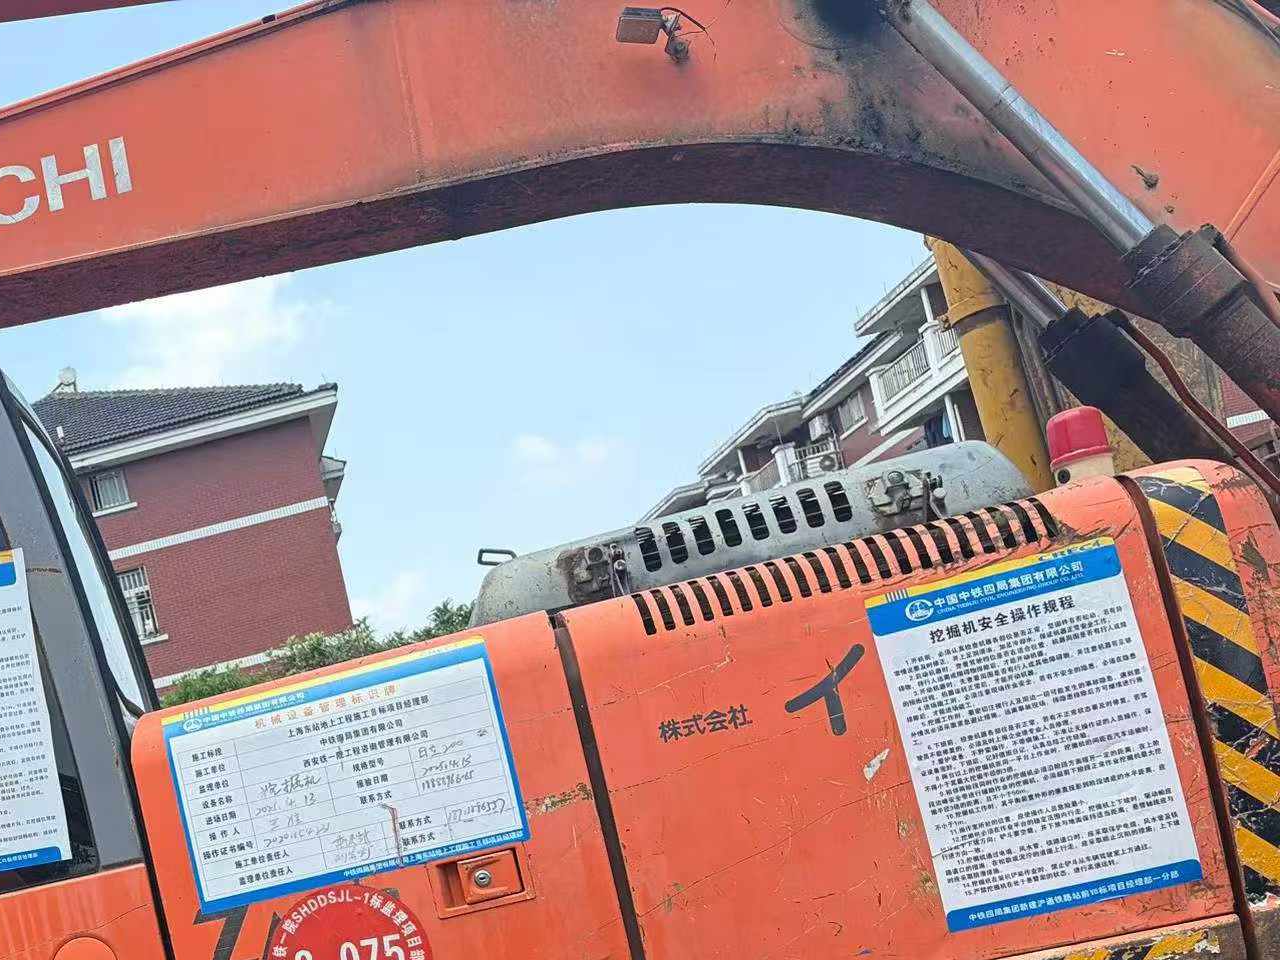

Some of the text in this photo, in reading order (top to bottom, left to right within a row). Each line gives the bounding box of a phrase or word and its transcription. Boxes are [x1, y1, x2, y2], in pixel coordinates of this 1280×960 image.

[932, 559, 1083, 608] 中国中铁四局集团有限公司
[928, 593, 1075, 644] 挖掘机安全操作规程
[658, 703, 754, 744] 株式会社
[191, 747, 222, 762] 施工标段
[194, 762, 226, 777] 施工单位
[351, 757, 385, 772] 规格型号
[198, 778, 230, 793] 监理单位
[355, 773, 389, 789] 报验日期
[201, 794, 233, 809] 设备名称
[358, 789, 392, 805] 联系方式
[204, 810, 237, 825] 进场日期
[398, 814, 432, 830] 联系方式
[202, 840, 254, 860] 操作证书编号
[234, 849, 290, 869] 施工单位责任人
[237, 865, 293, 885] 监理单位责任人
